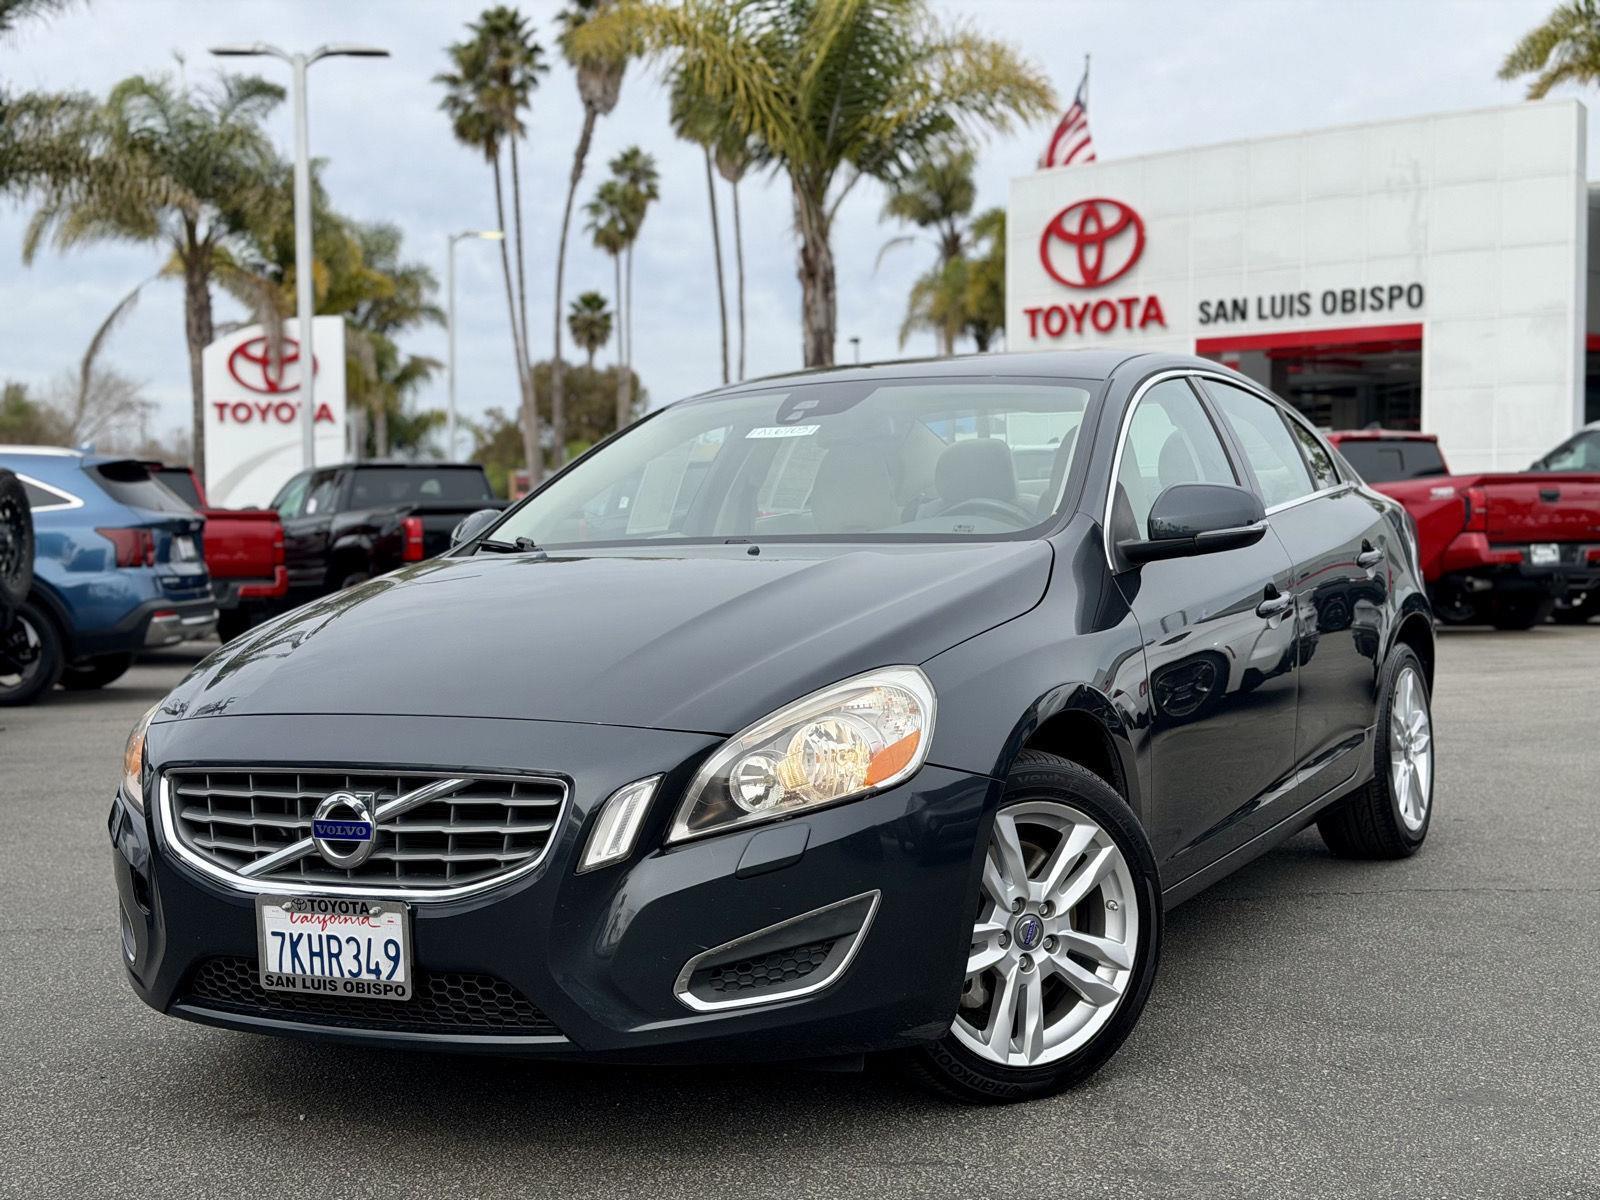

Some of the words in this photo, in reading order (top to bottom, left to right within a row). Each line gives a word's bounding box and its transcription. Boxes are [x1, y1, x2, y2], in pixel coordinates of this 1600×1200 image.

[1199, 298, 1248, 325] SAN
[1257, 292, 1311, 320] LUIS
[1321, 283, 1424, 315] OBISPO
[1023, 296, 1166, 339] TOYOTA
[213, 402, 336, 424] TOYOA
[316, 824, 367, 836] VOLVO
[307, 899, 370, 916] TOYOTA
[271, 931, 401, 981] 7KHR349
[265, 974, 297, 989] SAN
[302, 977, 338, 992] LUIS
[343, 981, 406, 997] OBISPO
